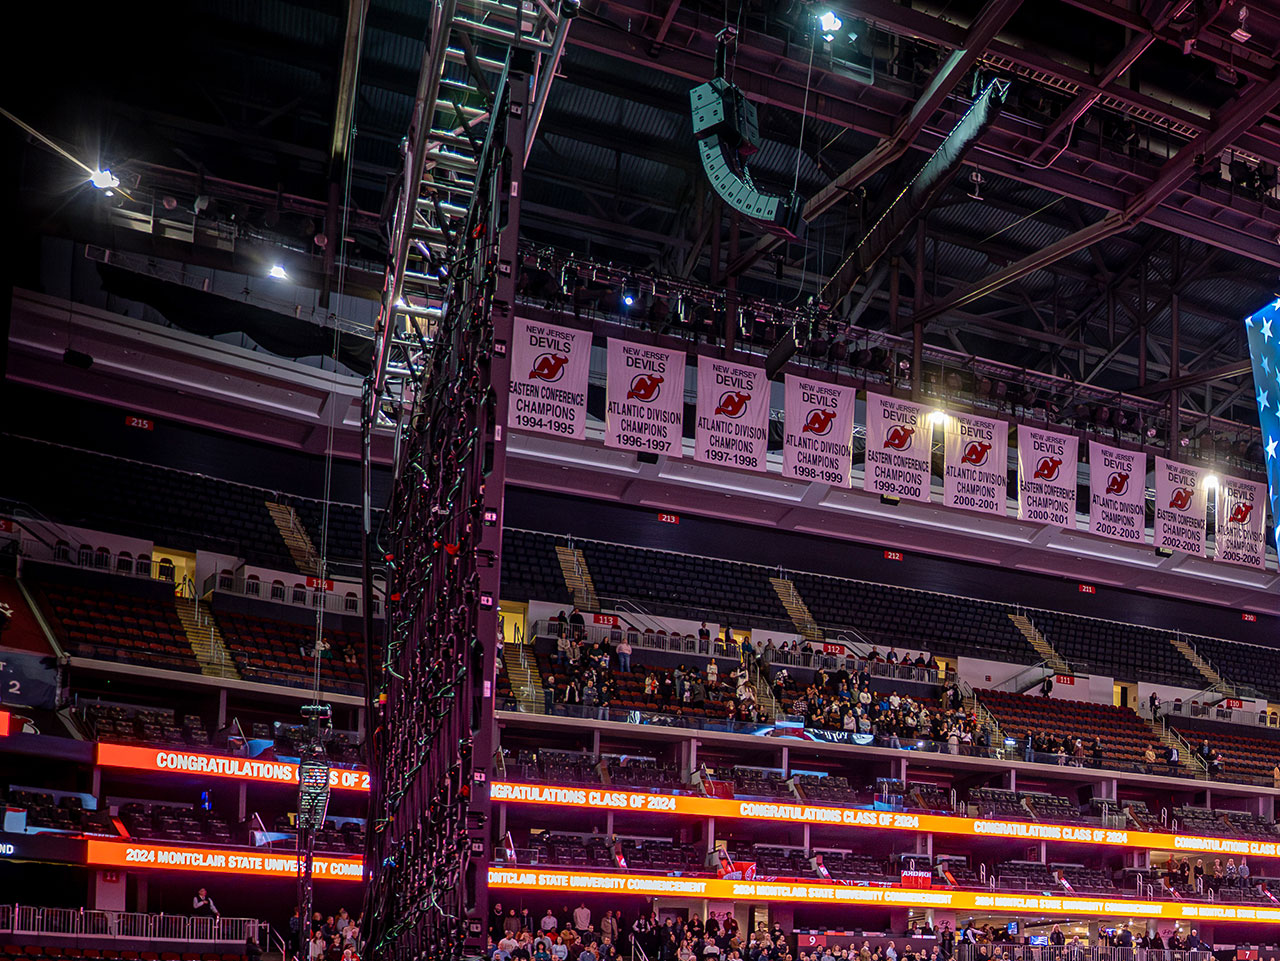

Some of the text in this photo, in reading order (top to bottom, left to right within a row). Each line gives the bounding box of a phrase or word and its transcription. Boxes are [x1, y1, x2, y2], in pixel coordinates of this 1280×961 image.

[526, 325, 576, 342] NEW JERSEY
[529, 335, 571, 353] DEVILS
[623, 346, 670, 362] NEW JERSEY
[626, 357, 666, 373] DEVILS
[713, 364, 757, 379] NEW JERSEY
[716, 374, 754, 391] DEVILS
[799, 382, 842, 398] NEW JERSEY
[509, 381, 584, 407] EASTERN CONFERENCE
[802, 392, 838, 408] DEVILS
[516, 399, 575, 421] CHAMPIONS
[608, 402, 681, 425] ATLANTIC DIVISION
[880, 399, 920, 415] NEW JERSEY
[131, 417, 149, 429] 215
[515, 415, 574, 435] 1994-1995
[883, 409, 917, 425] DEVILS
[957, 416, 996, 431] NEW JERSEY
[621, 419, 668, 438] CHAMPIONS
[698, 417, 767, 441] ATLANTIC DIVISION
[960, 425, 993, 441] DEVILS
[616, 434, 671, 452] 1996-1997
[709, 435, 754, 454] CHAMPIONS
[785, 434, 851, 457] ATLANTIC DIVISION
[1030, 432, 1067, 445] NEW JERSEY
[1033, 441, 1064, 455] DEVILS
[1101, 449, 1135, 463] NEW JERSEY
[704, 449, 758, 468] 1997-1998
[797, 451, 840, 471] CHAMPIONS
[867, 450, 929, 473] EASTERN CONFERENCE
[1104, 457, 1132, 473] DEVILS
[792, 465, 843, 484] 1998-1999
[874, 466, 922, 486] CHAMPIONS
[946, 465, 1006, 487] ATLANTIC DIVISION
[1166, 463, 1199, 478] NEW JERSEY
[1168, 472, 1196, 488] DEVILS
[873, 480, 921, 498] 1999-2000
[956, 481, 996, 499] CHAMPIONS
[1020, 480, 1075, 500] EASTERN CONFERENCE
[1228, 488, 1255, 502] DEVILS
[953, 495, 999, 511] 2000-2001
[1027, 495, 1069, 513] CHAMPIONS
[1092, 494, 1144, 516] ATLANTIC DIVISION
[662, 514, 676, 523] 213
[1027, 509, 1068, 525] 2000-2001
[1101, 510, 1135, 528] CHAMPIONS
[1157, 508, 1206, 531] EASTERN CONFERENCE
[1096, 521, 1141, 540] 2002-2003
[1162, 523, 1201, 542] CHAMPIONS
[1162, 536, 1201, 553] 2002-2003
[887, 552, 900, 560] 212
[1222, 550, 1261, 566] 2005-2006
[1082, 585, 1092, 593] 211
[599, 616, 613, 625] 113
[827, 645, 841, 654] 112
[1060, 676, 1071, 684] 111
[156, 751, 292, 781] CONGRATULATIONS
[341, 772, 359, 787] OF
[588, 791, 627, 808] CLASS
[629, 795, 646, 808] OF
[647, 796, 676, 811] 2024
[740, 802, 919, 828] CONGRATULATIONS CLASS OF 2024
[126, 849, 263, 871] 2024 MONTCLAIR STATE
[538, 874, 569, 888] STATE
[570, 876, 626, 891] UNIVERSITY
[809, 936, 816, 946] 9
[1245, 951, 1250, 959] 7
